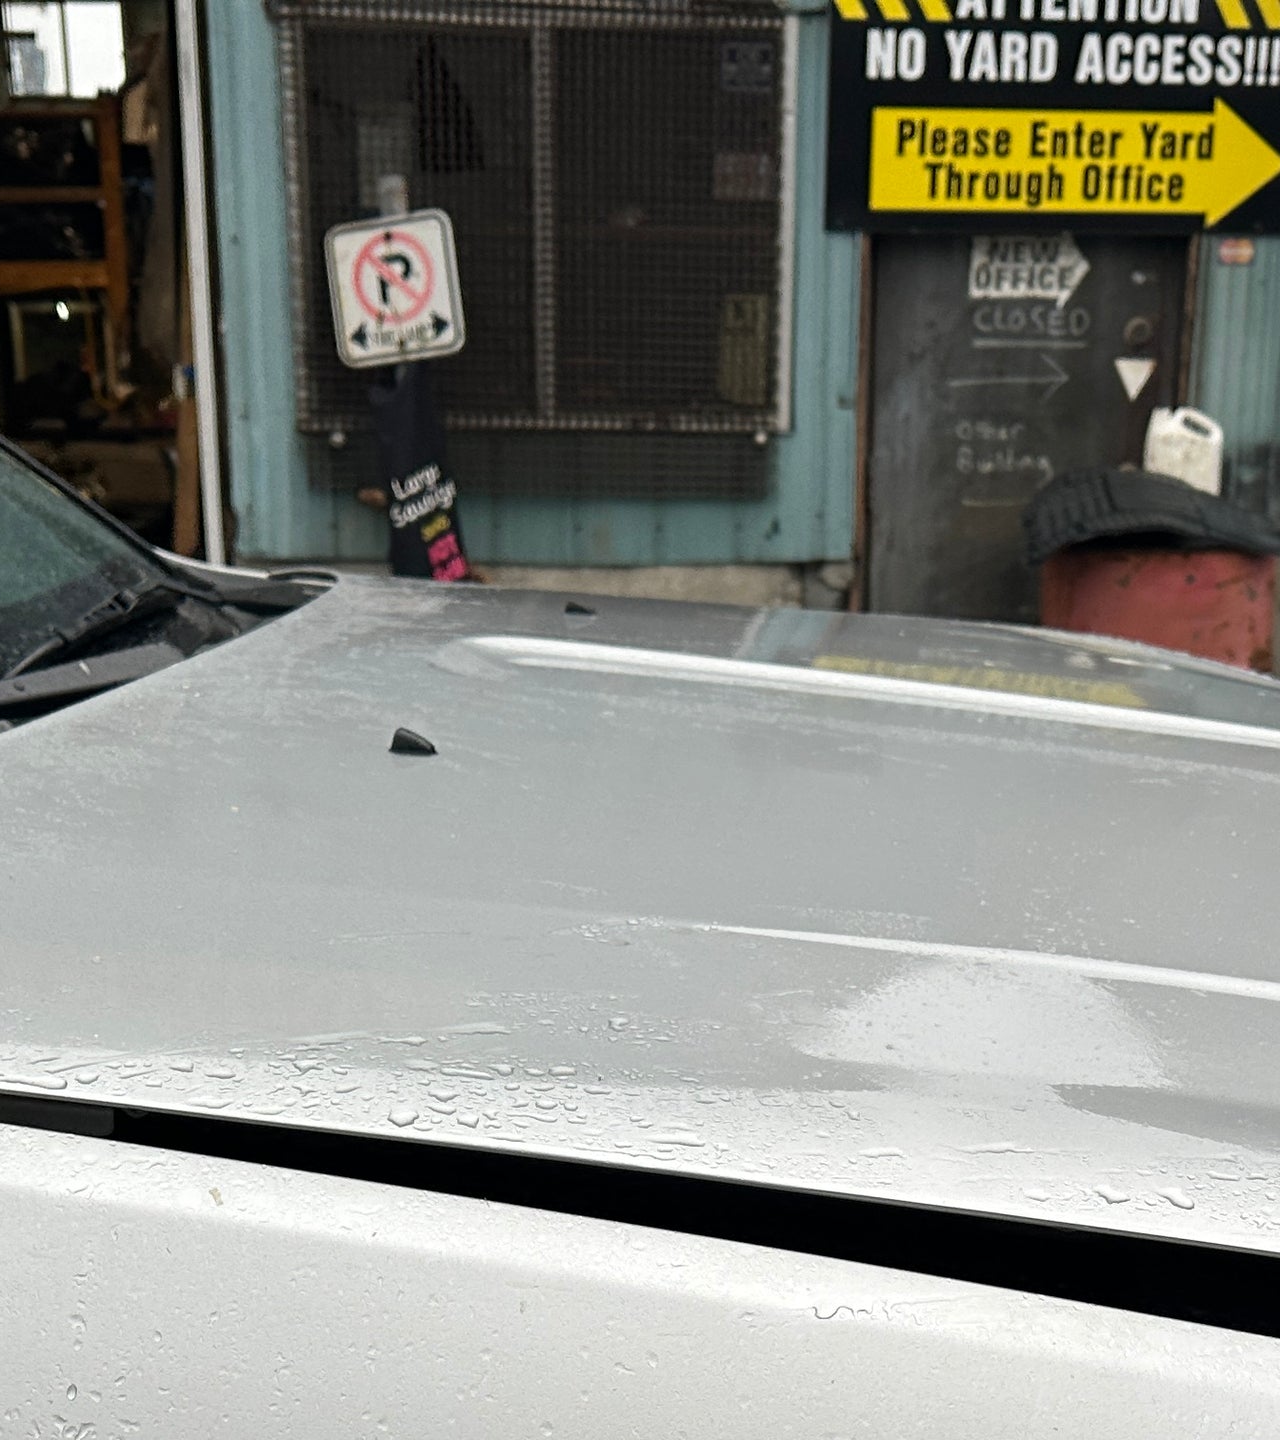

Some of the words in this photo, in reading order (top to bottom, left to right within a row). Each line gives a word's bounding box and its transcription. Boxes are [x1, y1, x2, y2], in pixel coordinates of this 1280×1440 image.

[866, 28, 926, 81] NO
[944, 30, 1058, 83] YARD
[897, 119, 1012, 158] Please
[1030, 120, 1123, 159] Enter
[1140, 123, 1214, 161] Yard
[925, 162, 1064, 207] Through
[1081, 165, 1185, 201] Office
[975, 261, 1073, 291] OFFICE
[972, 303, 1091, 337] CLOSED
